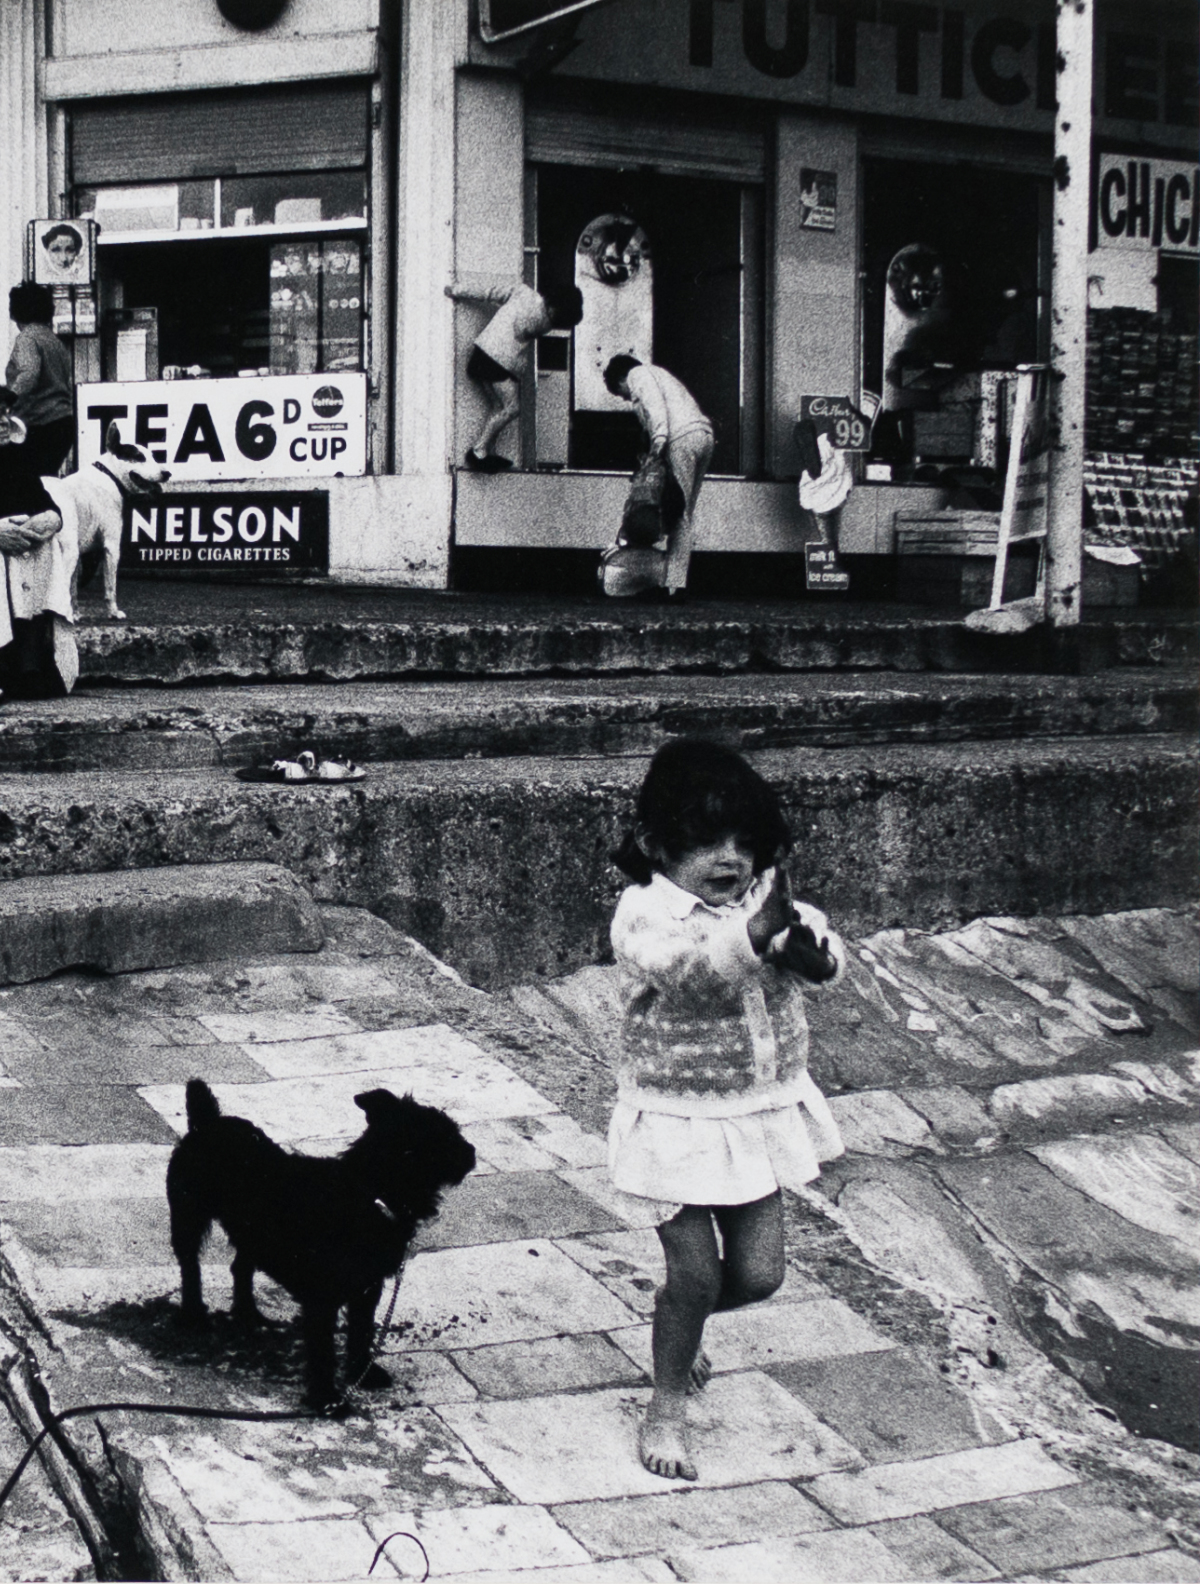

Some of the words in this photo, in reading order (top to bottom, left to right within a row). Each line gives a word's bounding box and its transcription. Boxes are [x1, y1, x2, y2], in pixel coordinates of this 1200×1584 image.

[87, 403, 226, 463] TEA
[235, 400, 277, 461] 6
[289, 437, 347, 462] CUP
[130, 506, 300, 543] NELSON
[139, 548, 192, 562] TIPPED
[197, 548, 290, 562] CIGARETTES
